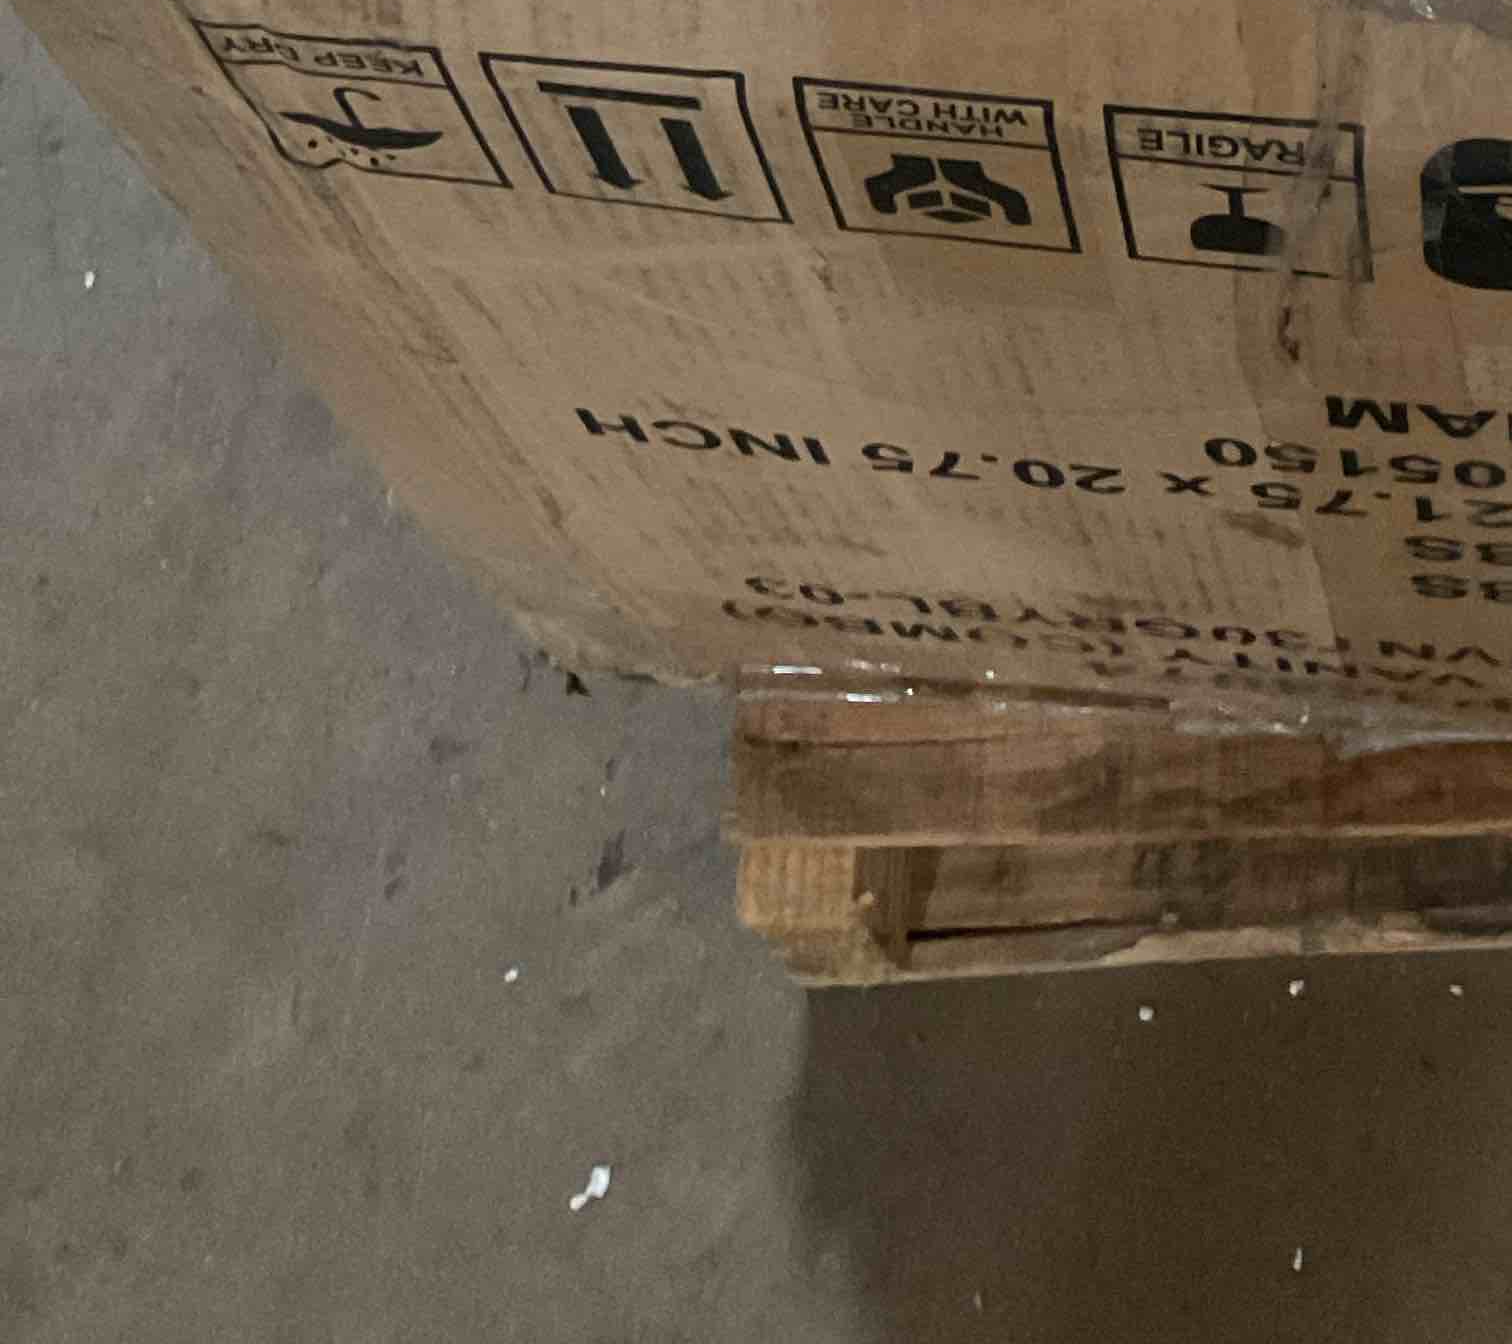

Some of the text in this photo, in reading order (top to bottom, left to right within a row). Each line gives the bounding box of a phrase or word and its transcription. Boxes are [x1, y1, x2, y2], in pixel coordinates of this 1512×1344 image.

[313, 50, 424, 77] KEEP
[816, 90, 1028, 127] WITH CARE
[853, 112, 1004, 137] HANDLE
[1136, 127, 1330, 169] RAGILE
[575, 407, 831, 466] INCH
[861, 442, 1126, 495] 20.75
